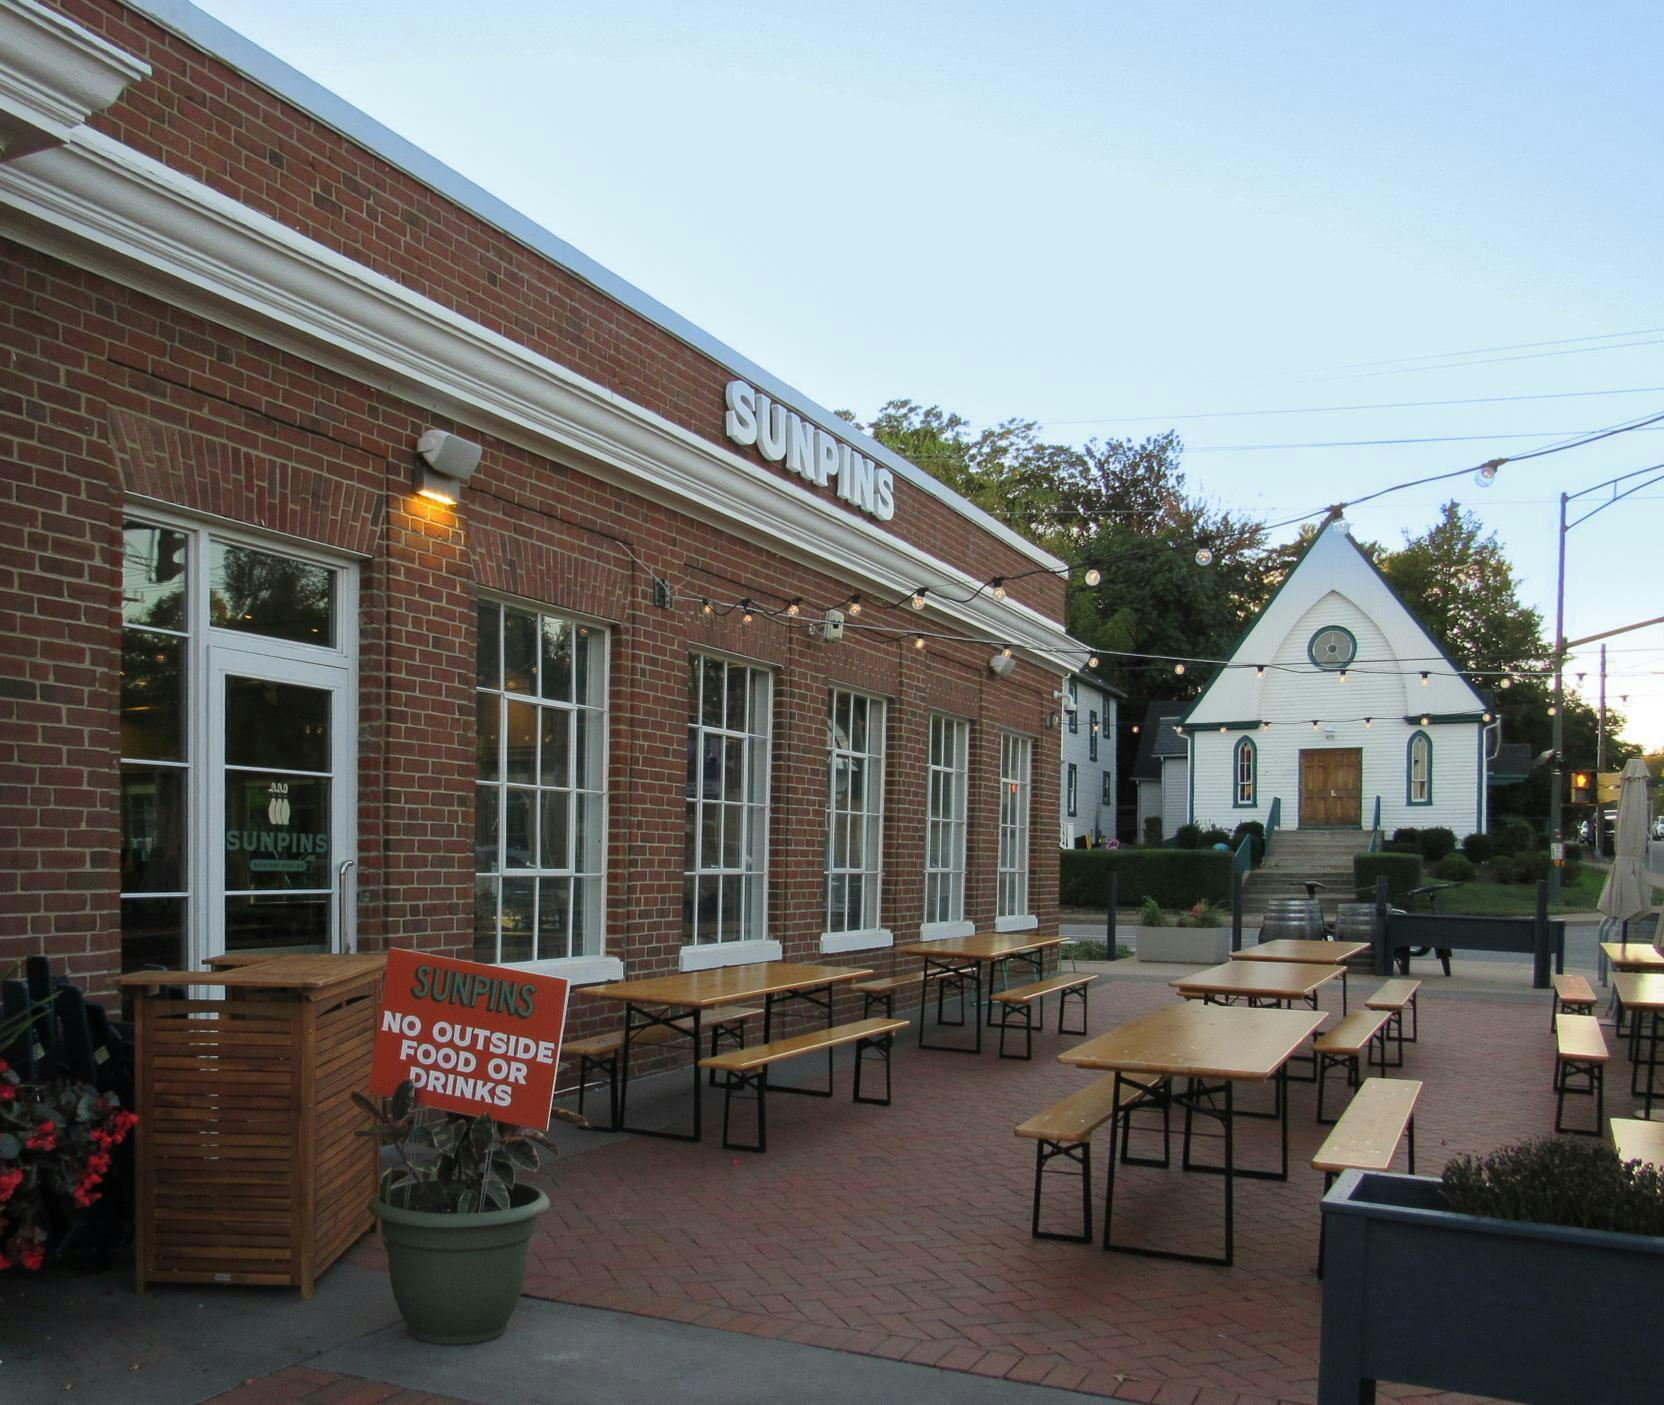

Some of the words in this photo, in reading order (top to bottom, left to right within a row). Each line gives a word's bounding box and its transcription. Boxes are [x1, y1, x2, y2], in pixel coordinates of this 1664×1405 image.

[725, 379, 895, 522] SUNPINS
[226, 830, 328, 853] SUNPINS
[411, 965, 537, 1019] SUNPINS
[381, 1010, 422, 1037] NO
[432, 1021, 555, 1065] OUTSIDE
[400, 1039, 477, 1073] FOOD
[487, 1058, 528, 1085] OR
[409, 1066, 512, 1107] DRINKS
